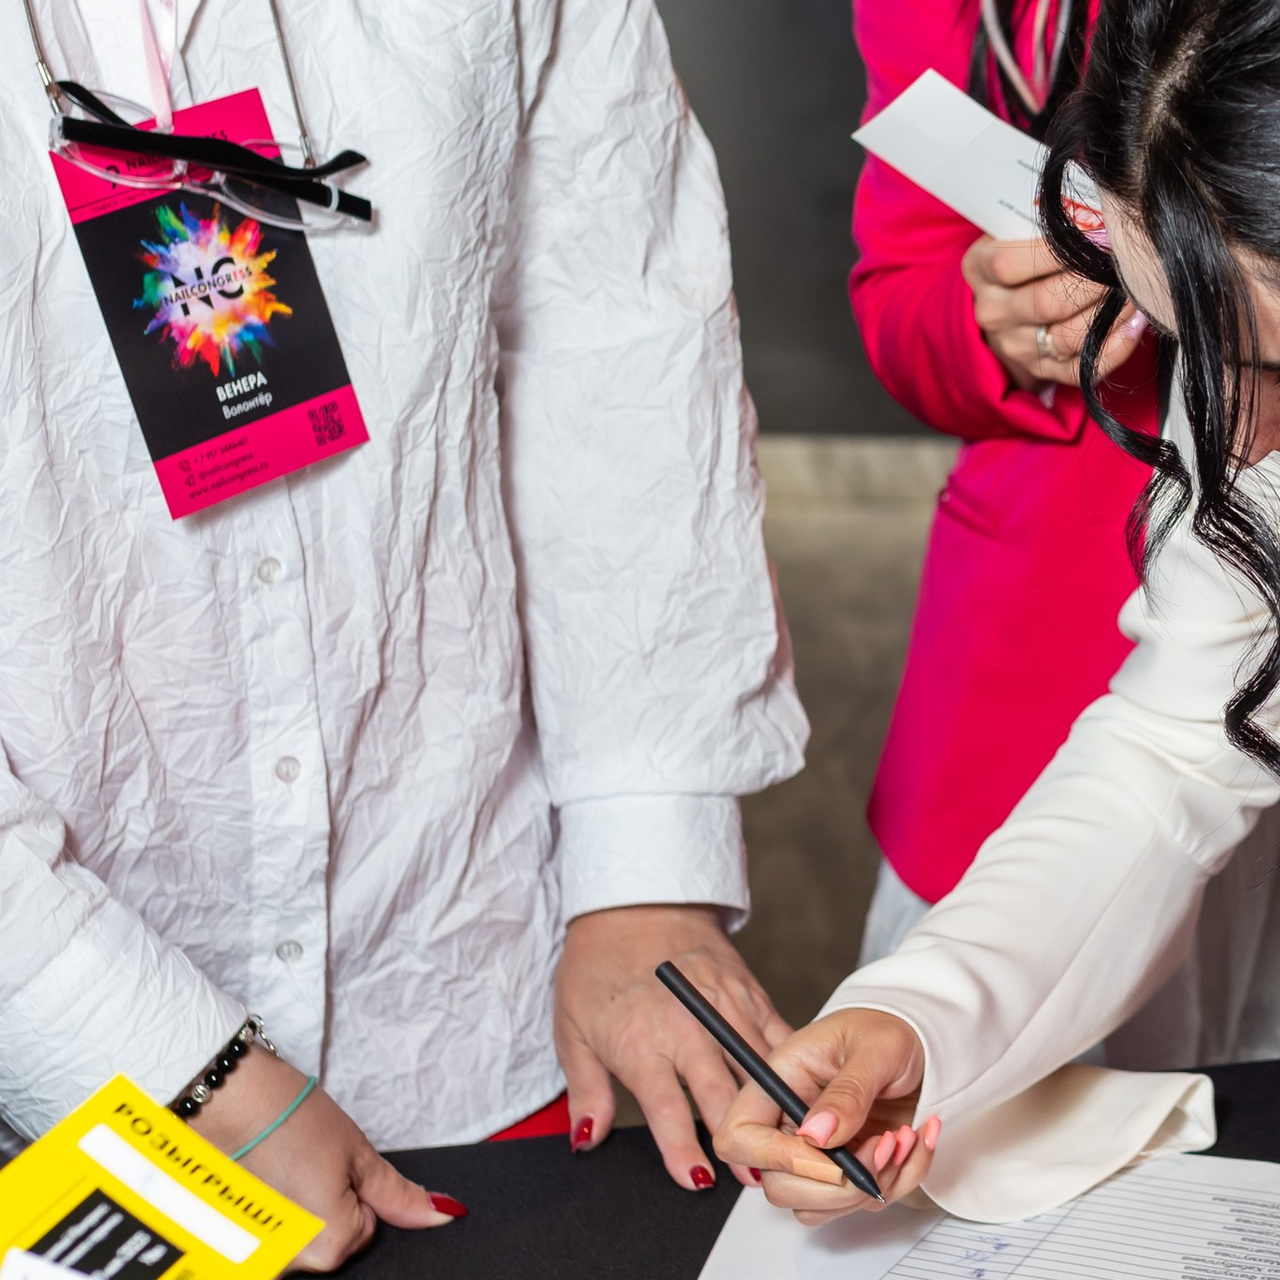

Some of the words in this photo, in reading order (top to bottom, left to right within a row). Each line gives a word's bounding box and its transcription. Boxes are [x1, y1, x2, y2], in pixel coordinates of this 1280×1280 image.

[163, 266, 252, 306] NAILCONGRESS
[216, 371, 268, 402] ВЕНЕРА
[222, 392, 272, 420] Волонтёр
[112, 1099, 286, 1233] РОЗЫГРЫШ!
